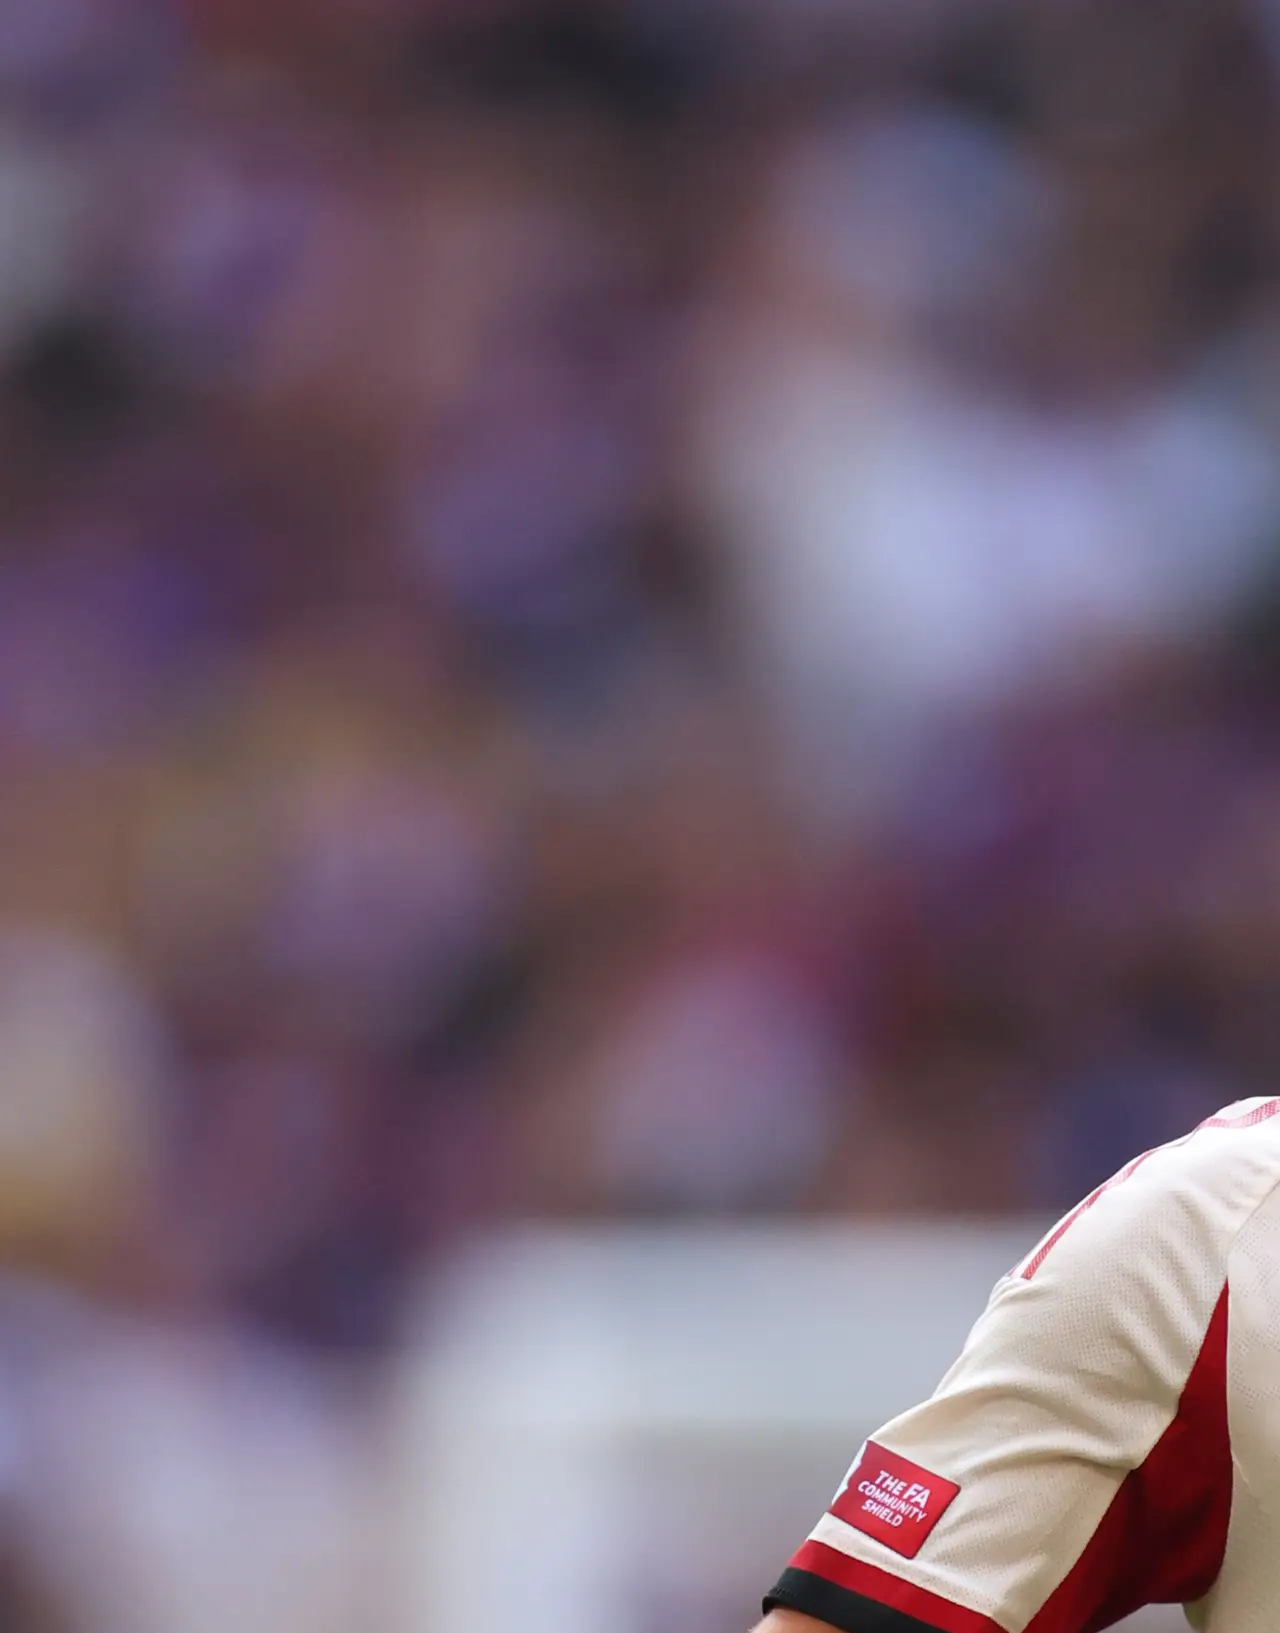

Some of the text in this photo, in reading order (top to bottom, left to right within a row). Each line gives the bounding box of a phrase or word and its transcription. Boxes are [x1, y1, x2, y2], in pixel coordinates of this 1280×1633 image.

[858, 1480, 928, 1523] COMMUNITY
[875, 1470, 931, 1509] THE FA
[861, 1499, 904, 1527] SHIELD
